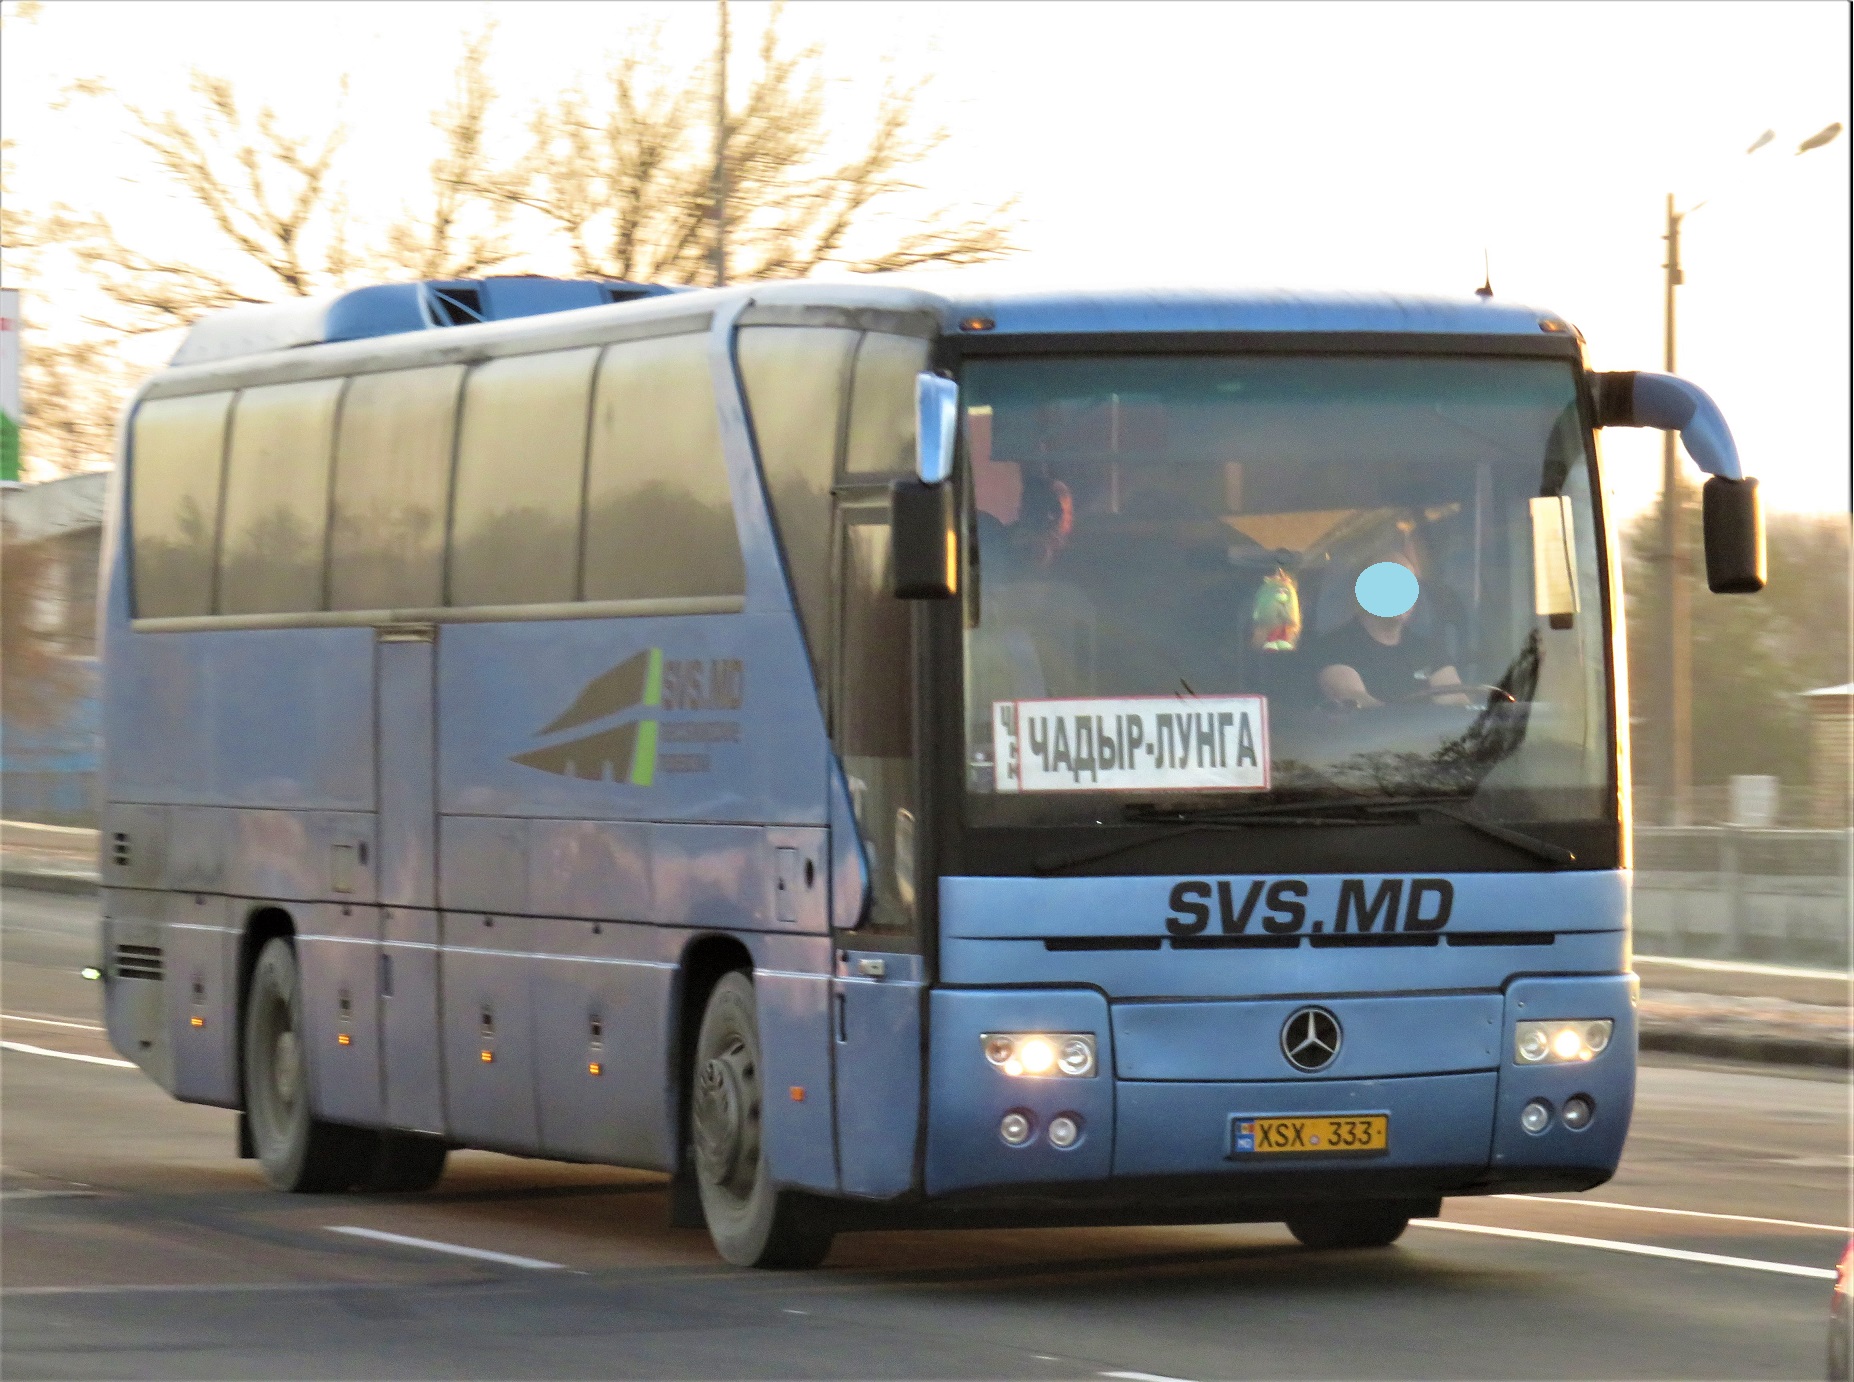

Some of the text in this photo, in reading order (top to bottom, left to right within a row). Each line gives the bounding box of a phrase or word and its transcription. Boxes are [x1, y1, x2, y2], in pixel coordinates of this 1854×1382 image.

[1028, 711, 1257, 783] ЧАДЫР-ЛУНГА
[1165, 878, 1454, 936] SVS.MD
[1258, 1120, 1373, 1148] XSX 333
